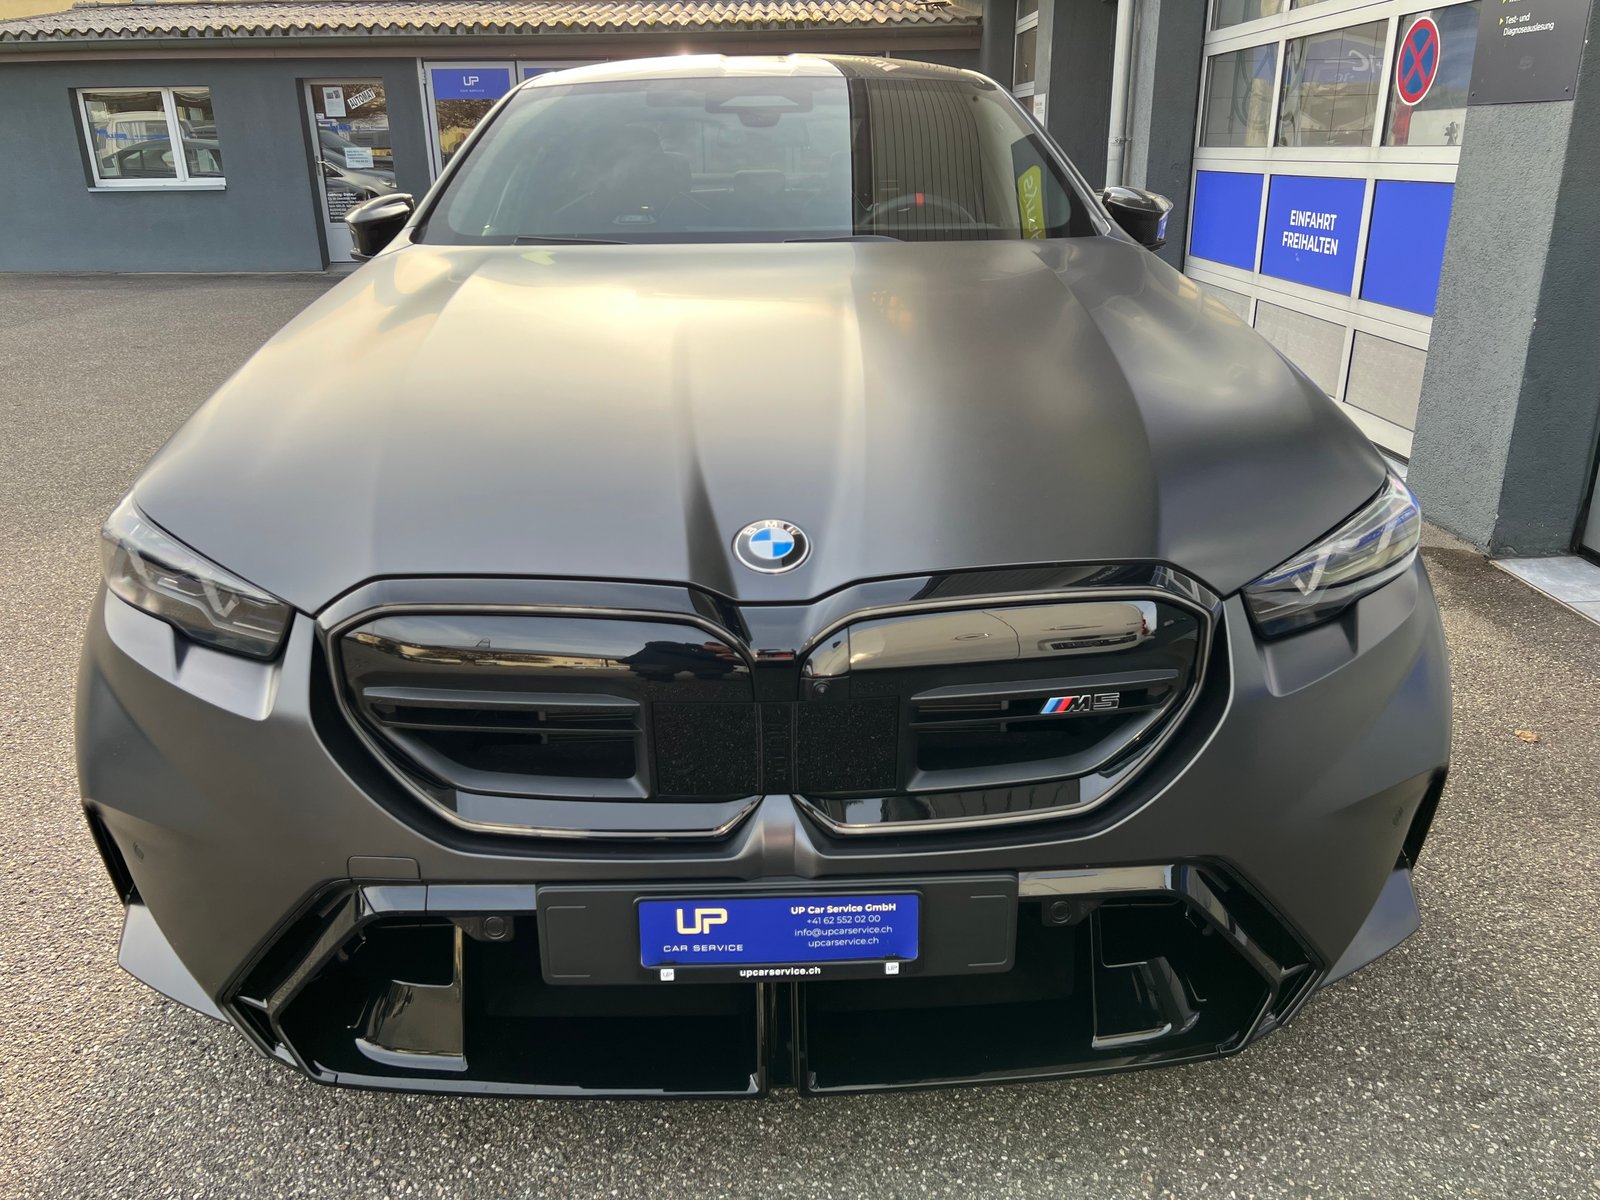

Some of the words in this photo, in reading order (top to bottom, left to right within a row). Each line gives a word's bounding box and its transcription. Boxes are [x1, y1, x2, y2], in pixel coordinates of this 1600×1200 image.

[1505, 15, 1519, 24] Test-
[1519, 12, 1531, 22] und
[1503, 22, 1555, 37] Diagnoseauslesung
[463, 76, 480, 86] UP
[349, 88, 375, 108] AUTOMAT
[1290, 209, 1337, 231] EINFAHRT
[1282, 231, 1339, 256] FREIHALTEN
[743, 520, 801, 536] BMW
[790, 906, 806, 915] UP
[808, 906, 825, 914] Car
[826, 903, 863, 914] Service
[865, 903, 897, 912] GmbH
[676, 908, 728, 934] UP
[807, 917, 821, 925] +41
[823, 916, 835, 924] 62
[836, 915, 853, 924] 552
[854, 915, 867, 923] 02
[868, 914, 881, 923] 00
[794, 925, 893, 937] info@upcarservice.ch
[663, 944, 688, 952] CAR
[693, 943, 744, 952] SERVICE
[808, 936, 880, 948] upcarservice.ch
[739, 966, 821, 978] upcarservice.ch
